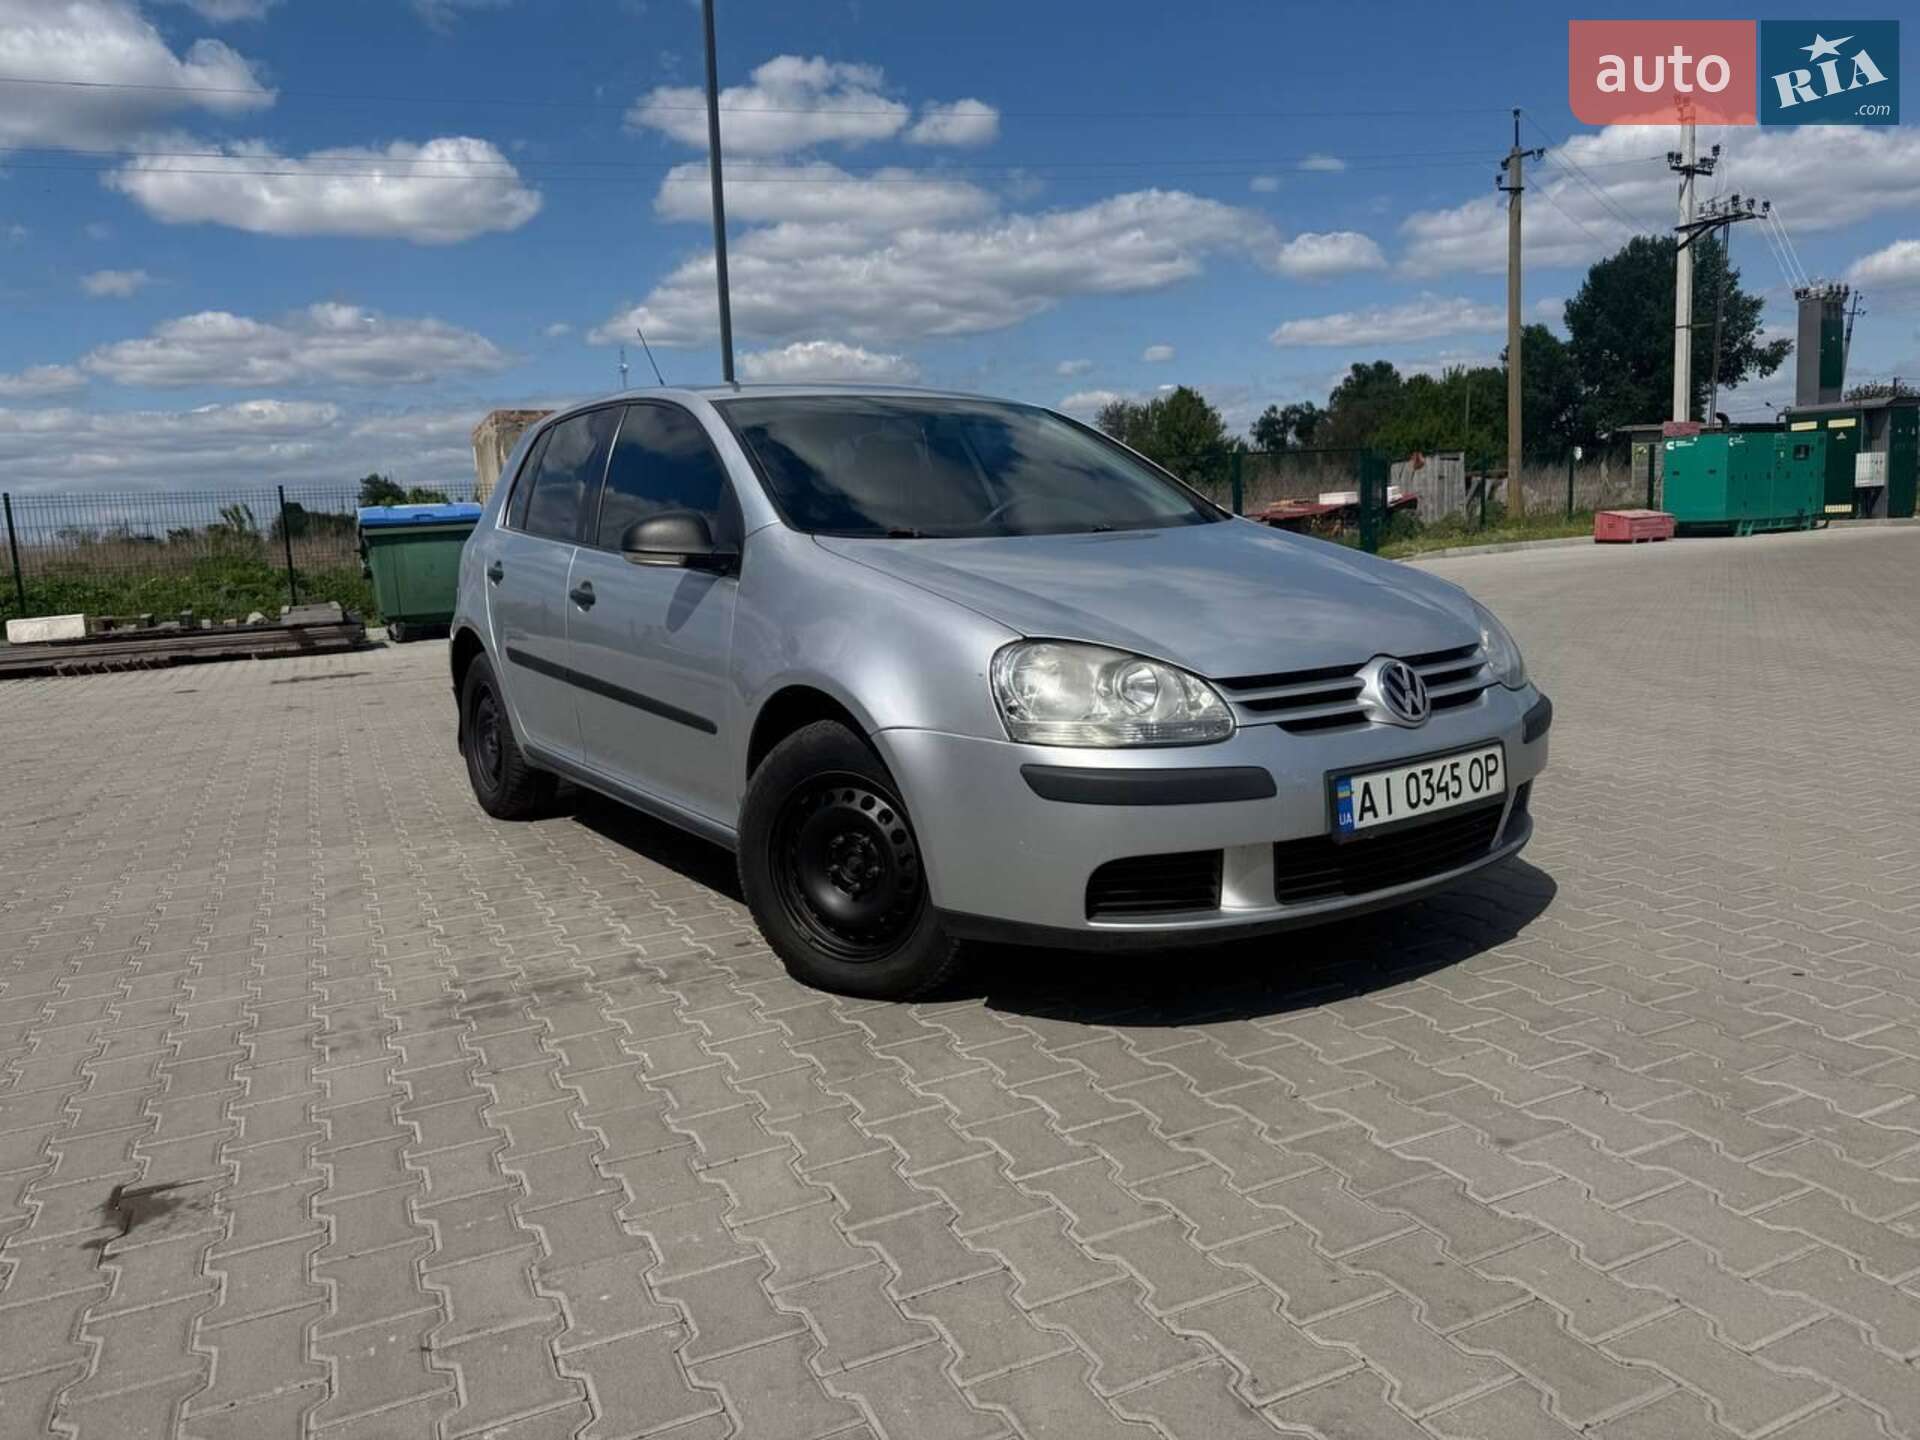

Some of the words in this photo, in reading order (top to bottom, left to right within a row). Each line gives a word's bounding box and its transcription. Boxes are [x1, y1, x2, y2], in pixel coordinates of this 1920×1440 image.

[1358, 777, 1393, 822] AI
[1405, 762, 1462, 810] 0345
[1468, 753, 1499, 793] OP
[1339, 812, 1353, 825] UA
